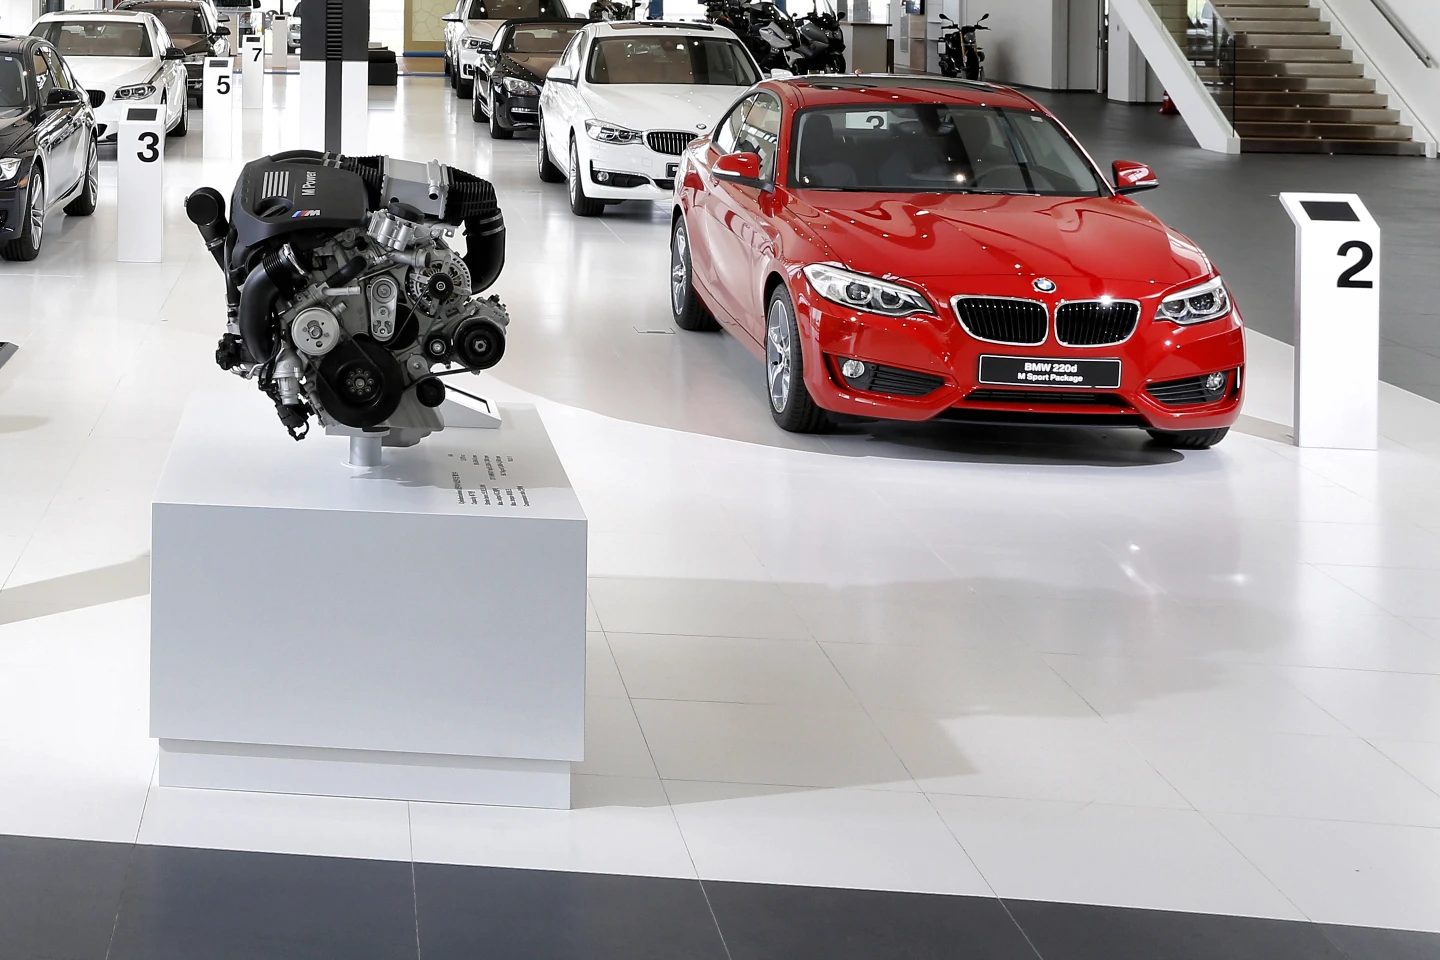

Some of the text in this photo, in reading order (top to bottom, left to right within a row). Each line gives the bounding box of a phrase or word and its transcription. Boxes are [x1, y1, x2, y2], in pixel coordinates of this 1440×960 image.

[251, 47, 262, 62] 7
[216, 75, 231, 95] 5
[137, 131, 160, 163] 3
[301, 171, 317, 196] M Power
[1336, 240, 1373, 289] 2
[1024, 362, 1078, 373] BMW 220d
[1026, 373, 1049, 382] Sport
[1050, 373, 1084, 383] Package
